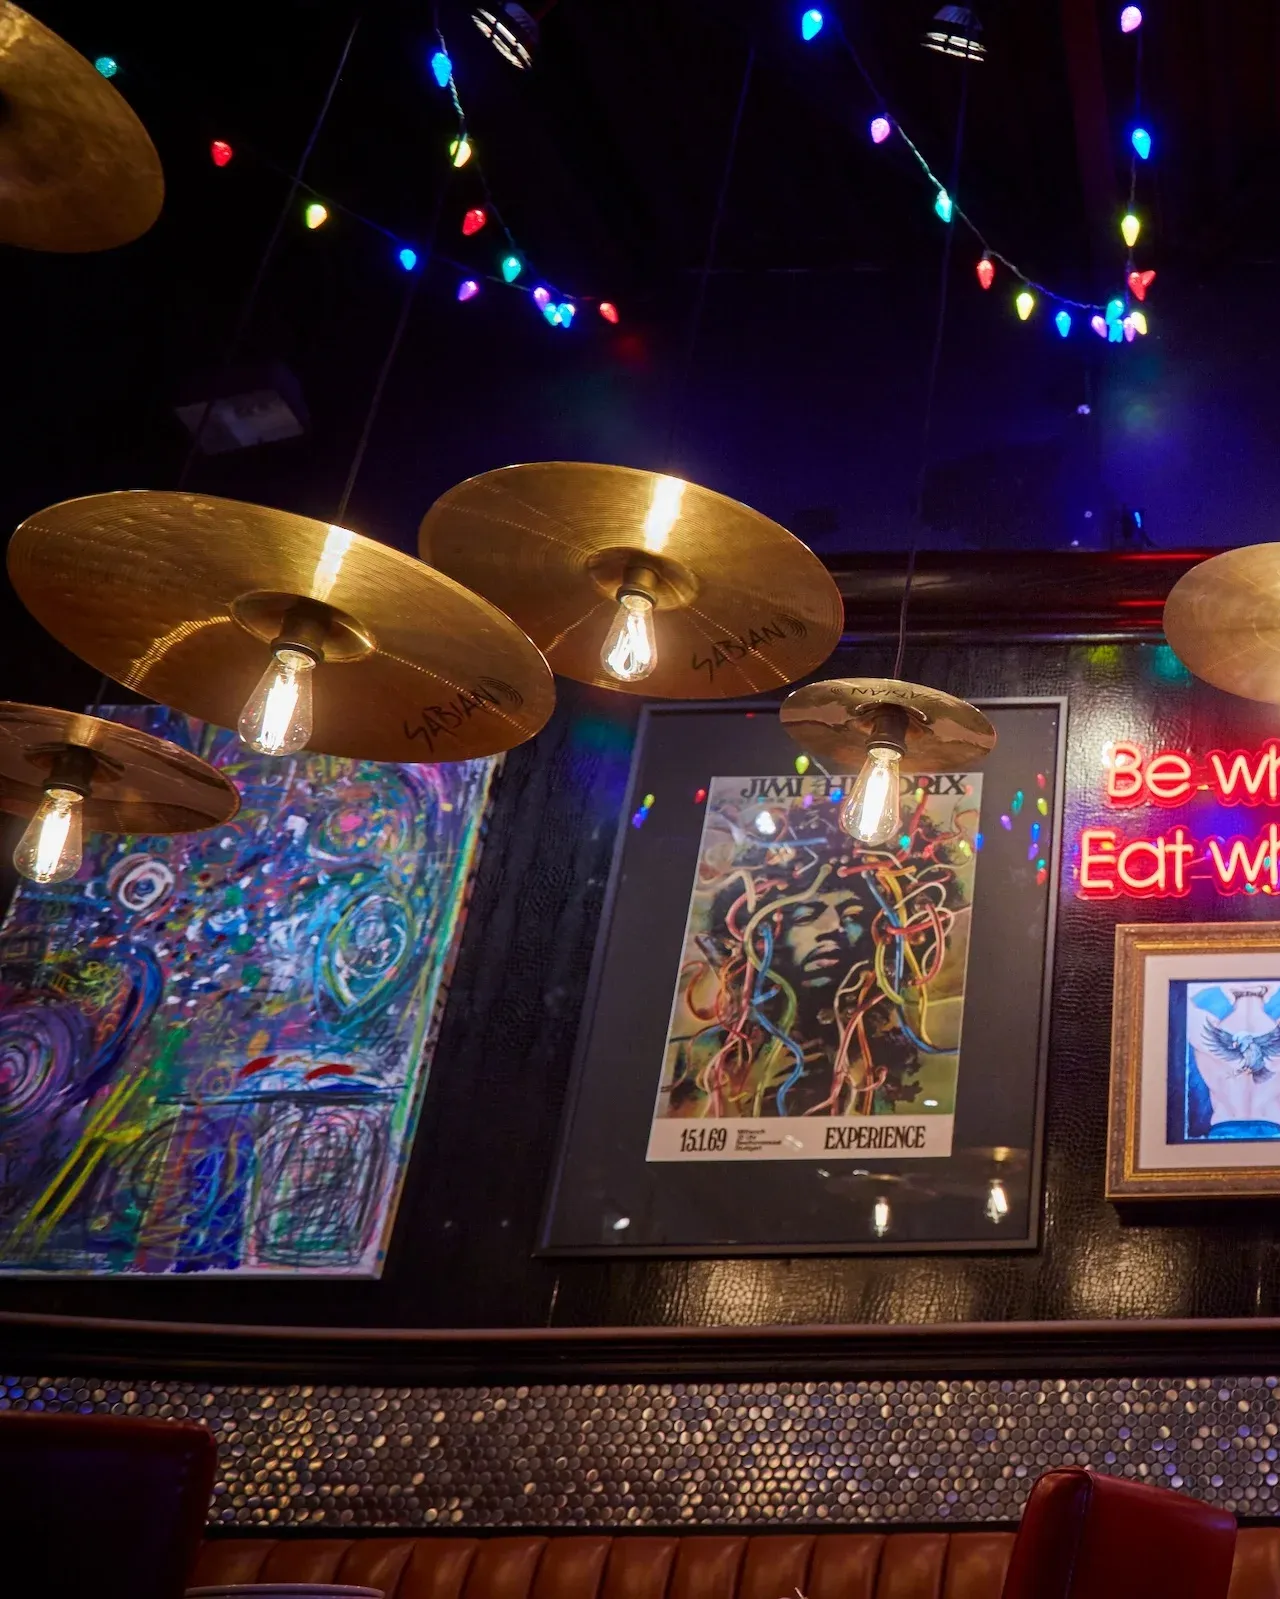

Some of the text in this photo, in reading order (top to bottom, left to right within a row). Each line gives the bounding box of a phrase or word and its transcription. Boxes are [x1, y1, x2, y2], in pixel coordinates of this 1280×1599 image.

[692, 621, 786, 684] SABIAN
[403, 684, 500, 754] SABIAN
[740, 776, 804, 799] JIMI
[1107, 742, 1192, 799] Be
[1081, 829, 1194, 889] Eat
[824, 1126, 926, 1149] EXPERIENCE
